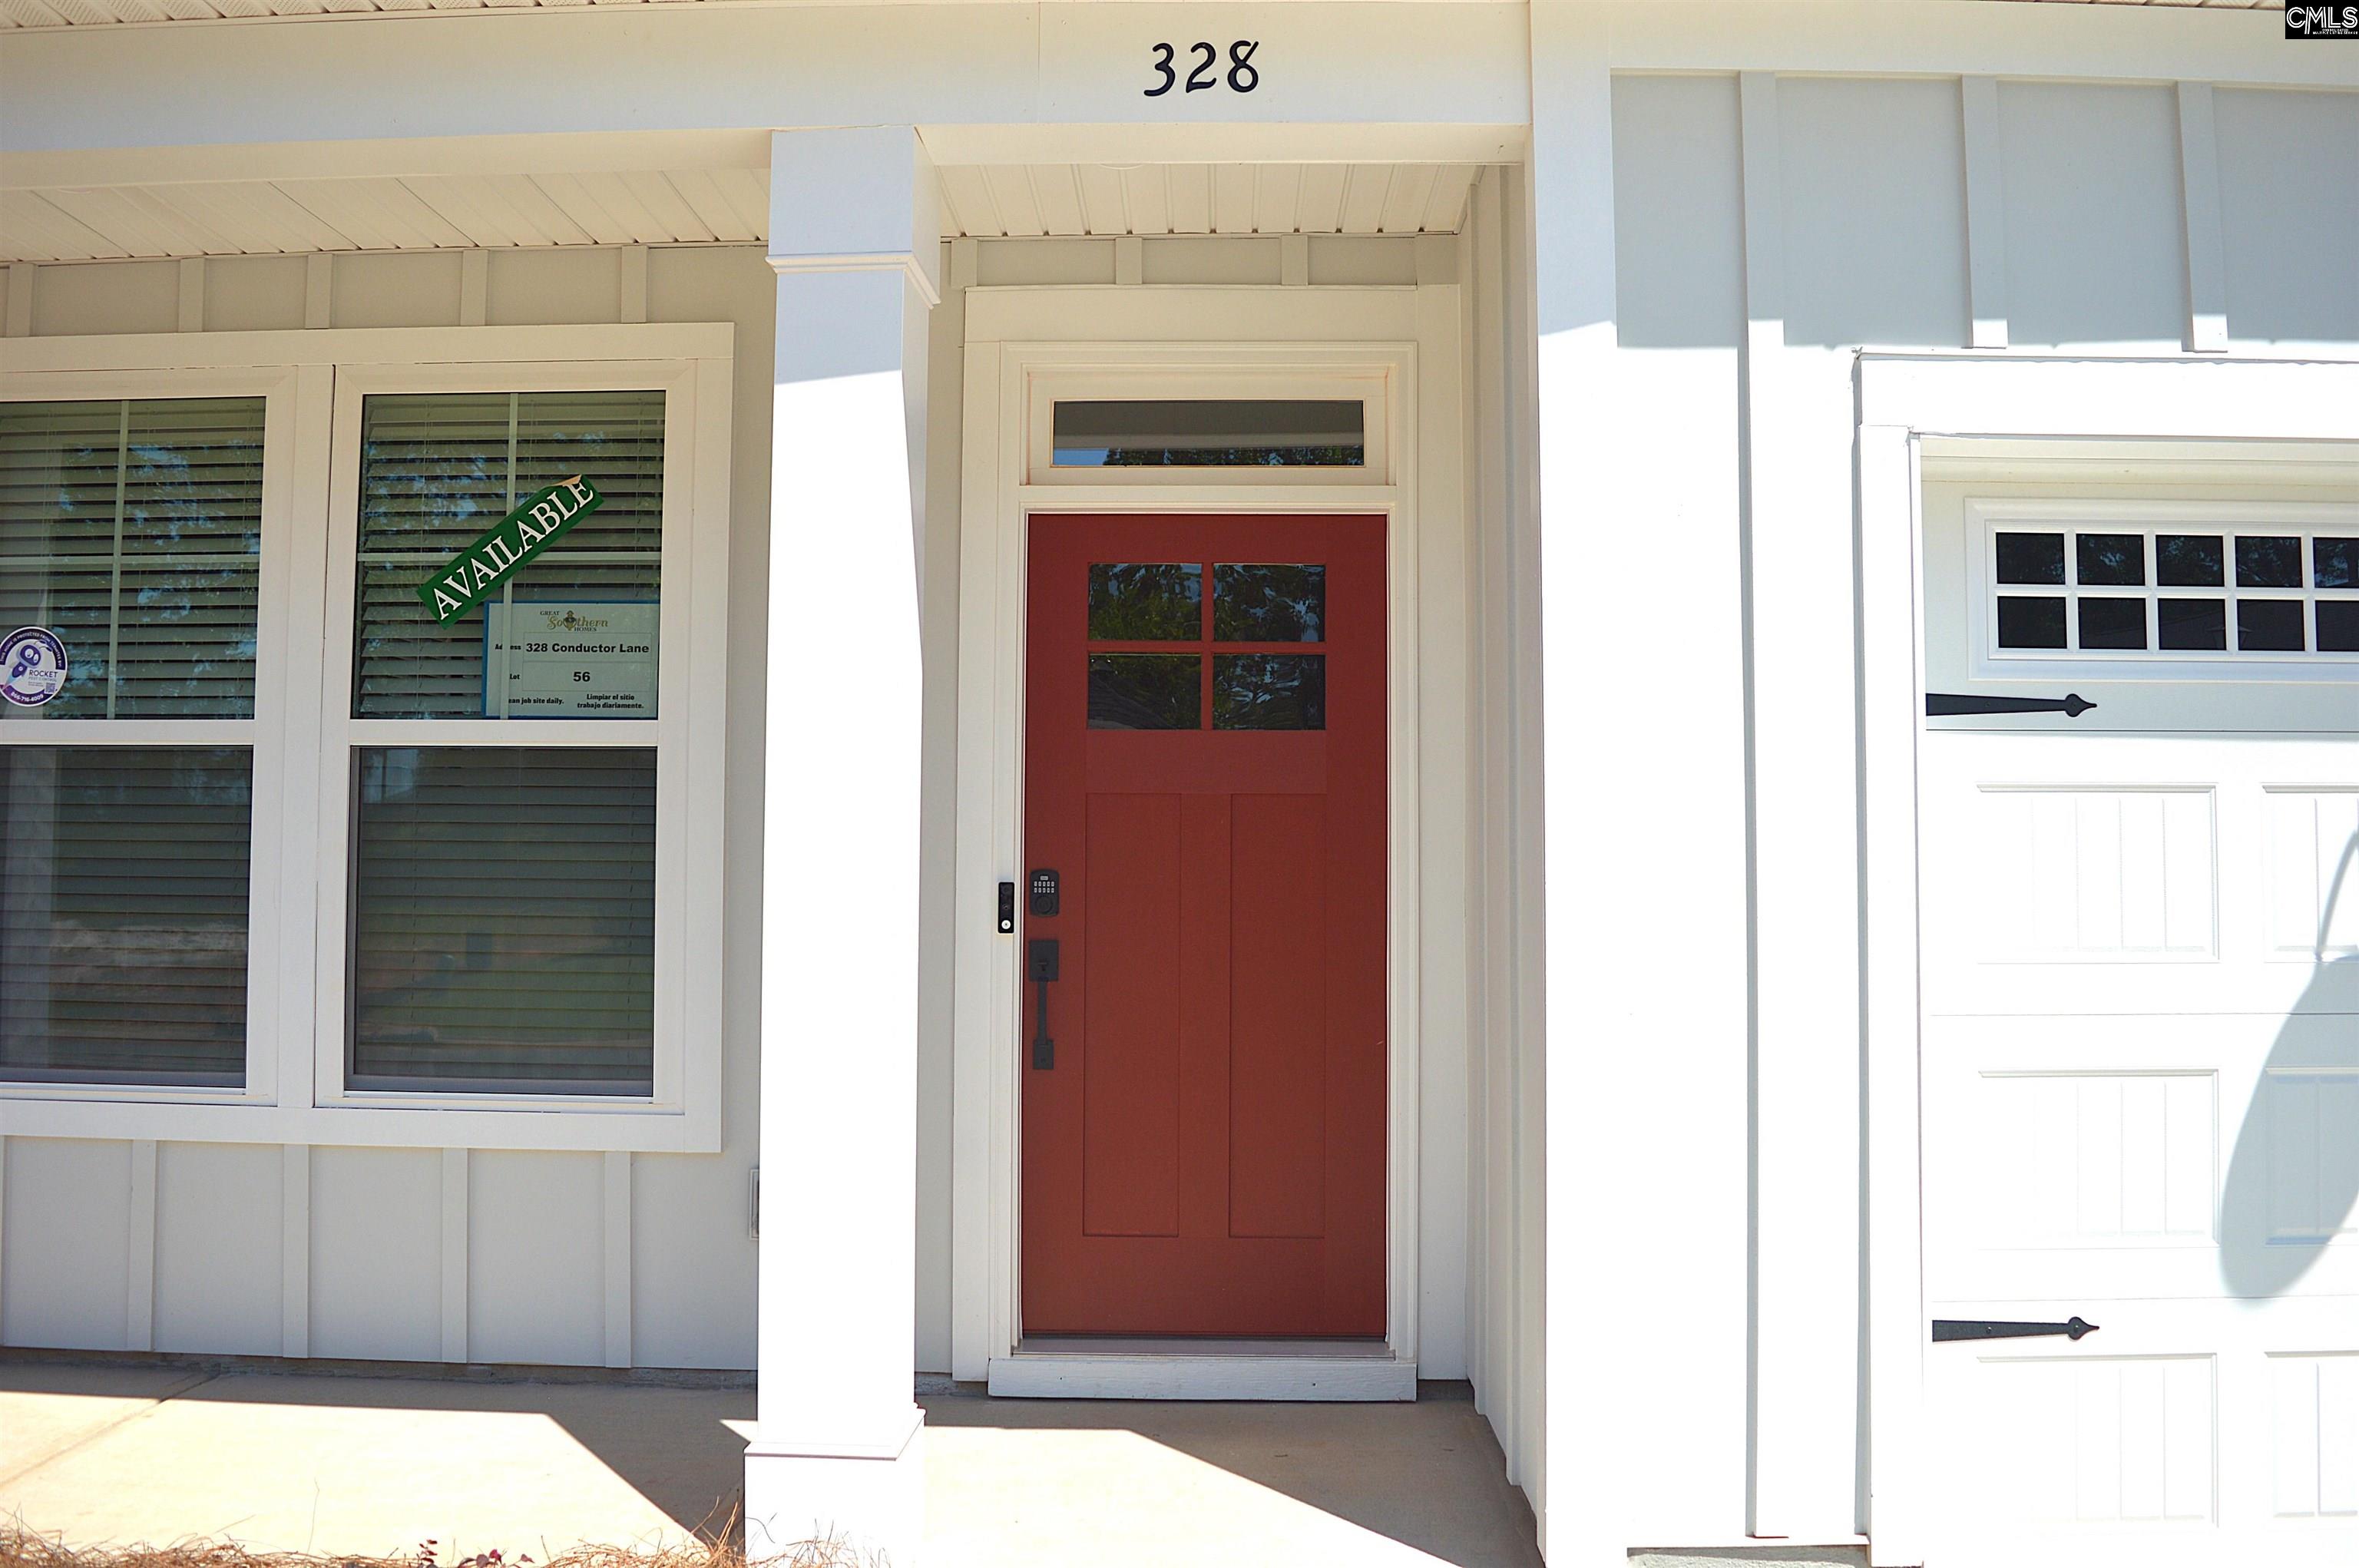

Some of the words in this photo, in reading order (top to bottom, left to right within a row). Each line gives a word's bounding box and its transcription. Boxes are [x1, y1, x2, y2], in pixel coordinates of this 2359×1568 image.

[1144, 40, 1259, 97] 328
[433, 481, 594, 620] AVAILABLE
[526, 643, 548, 652] 328
[552, 643, 616, 653] Conductor
[620, 643, 649, 653] Lane
[573, 672, 591, 682] 56
